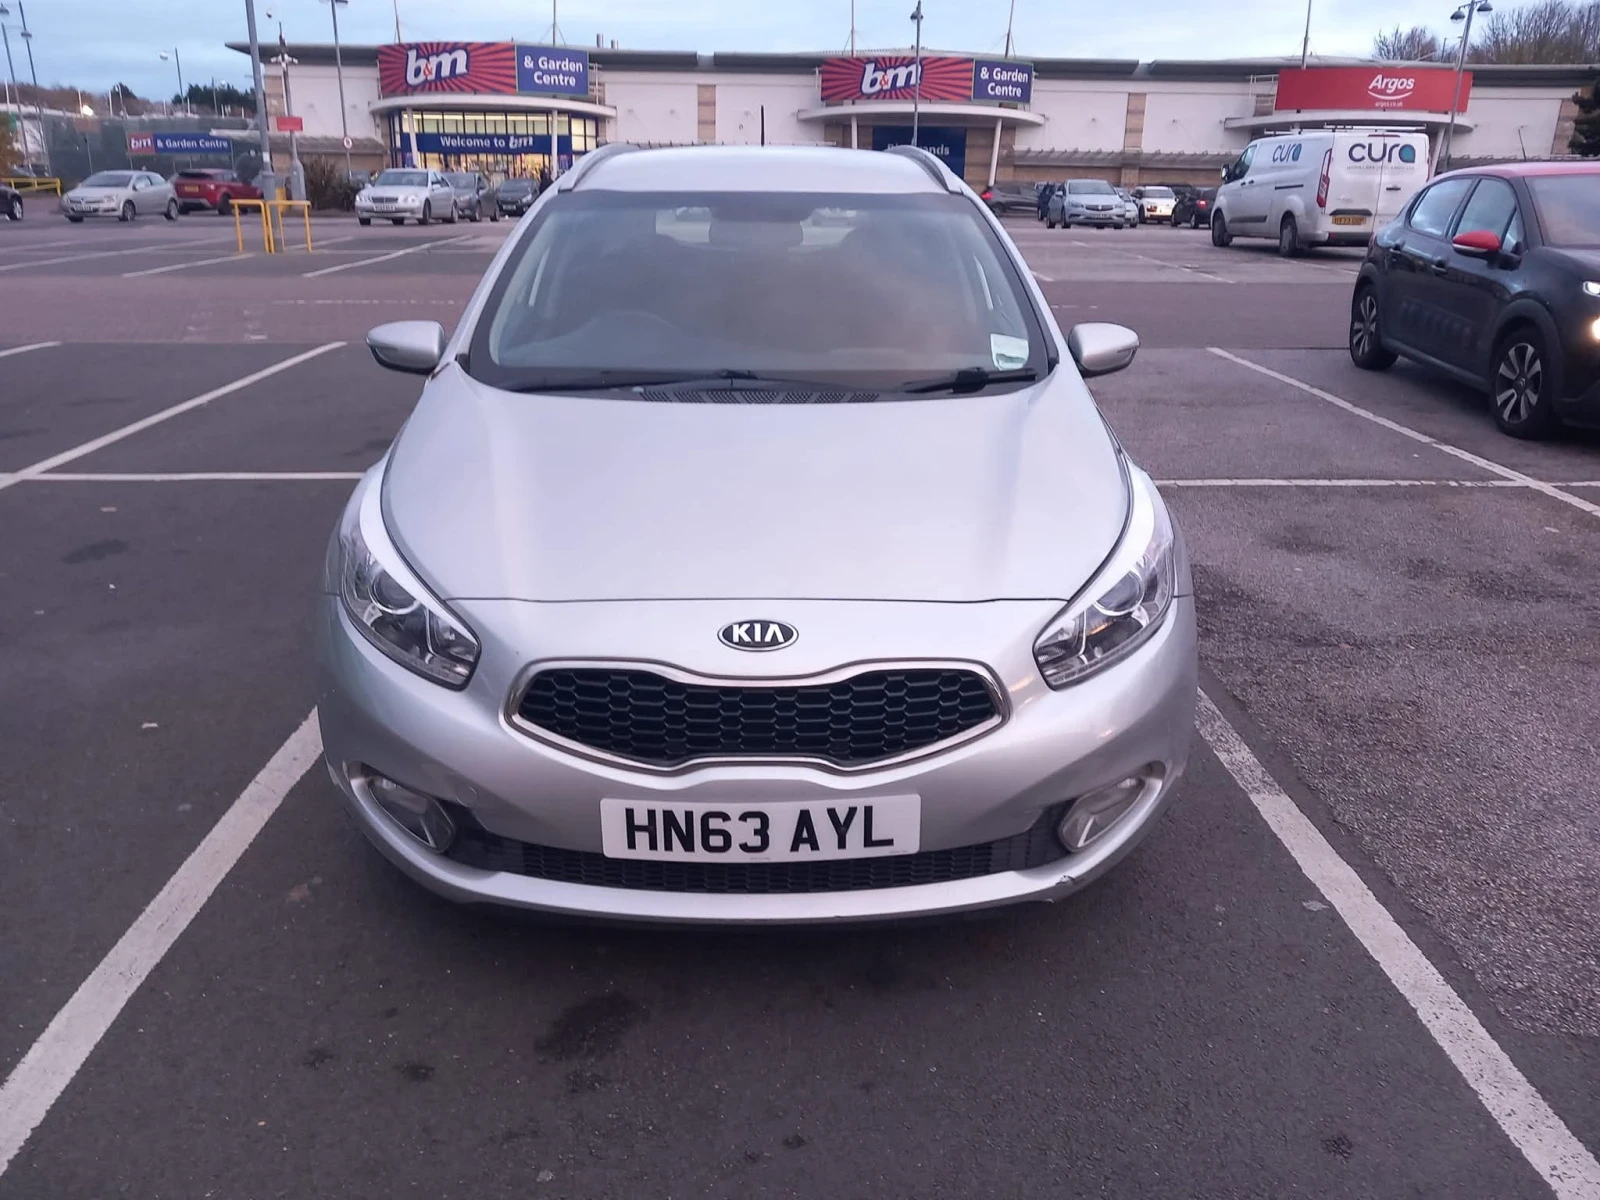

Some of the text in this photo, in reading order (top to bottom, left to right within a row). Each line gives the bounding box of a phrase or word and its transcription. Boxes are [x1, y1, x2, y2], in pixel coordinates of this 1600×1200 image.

[524, 55, 583, 73] & Garden
[533, 71, 576, 87] Centre
[980, 66, 1029, 83] & Garden
[987, 82, 1022, 97] Centre
[1368, 74, 1415, 94] Argos
[165, 138, 198, 149] Garden
[199, 138, 228, 149] Centre
[440, 135, 491, 147] Welcome
[493, 136, 506, 148] to
[732, 622, 785, 643] KIA
[624, 805, 895, 853] HN63 AYL
